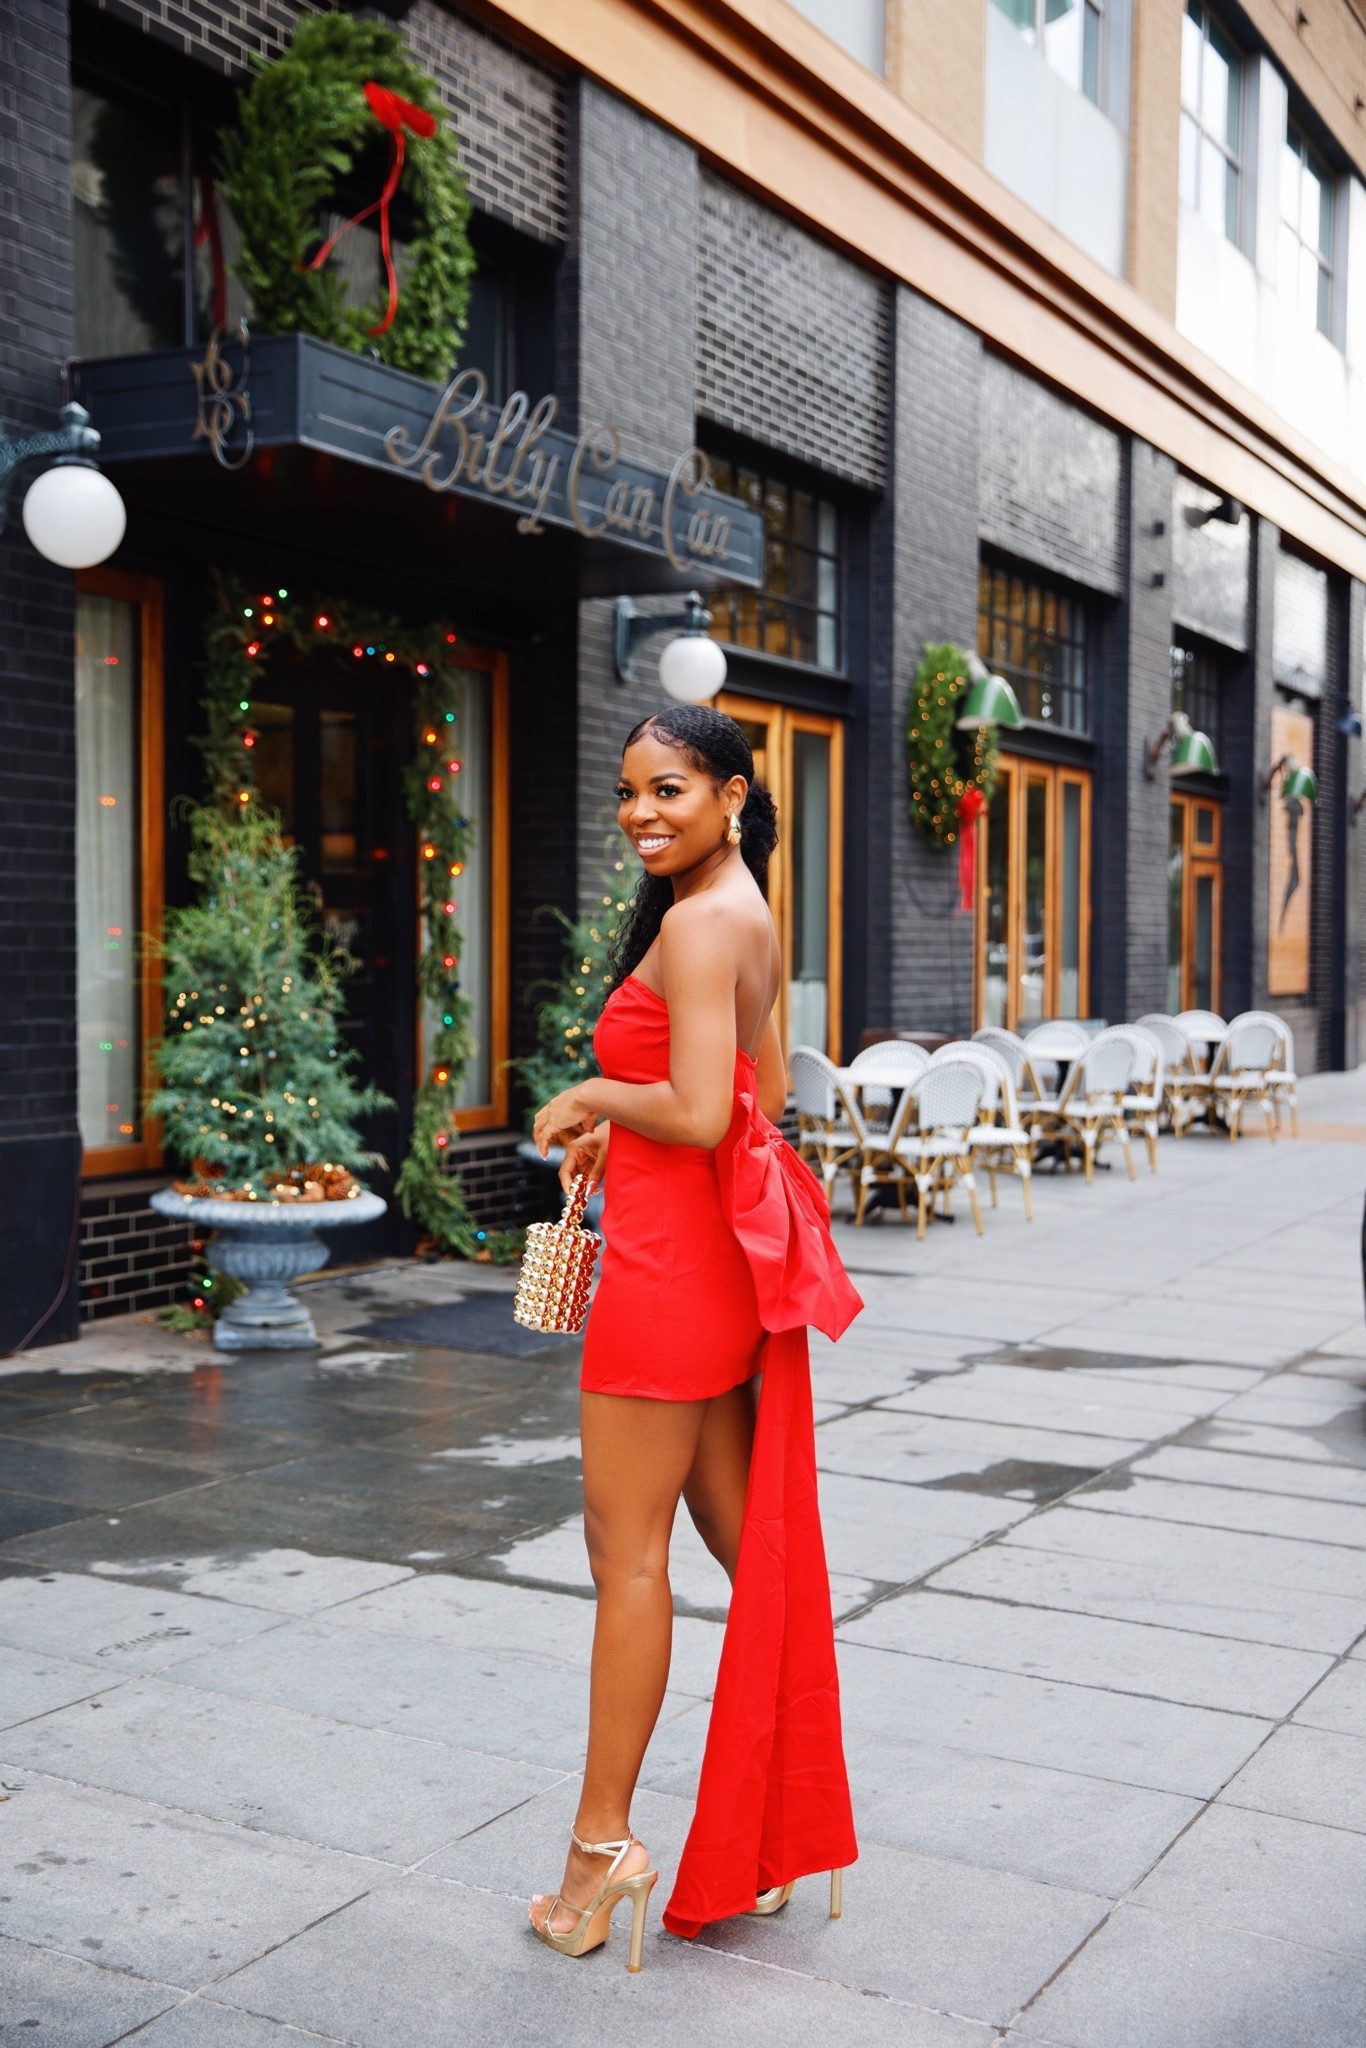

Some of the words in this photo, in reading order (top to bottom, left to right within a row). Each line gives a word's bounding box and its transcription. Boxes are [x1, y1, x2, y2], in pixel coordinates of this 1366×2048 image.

[384, 367, 560, 534] Billy
[567, 422, 655, 539] Can
[663, 447, 731, 572] Can
